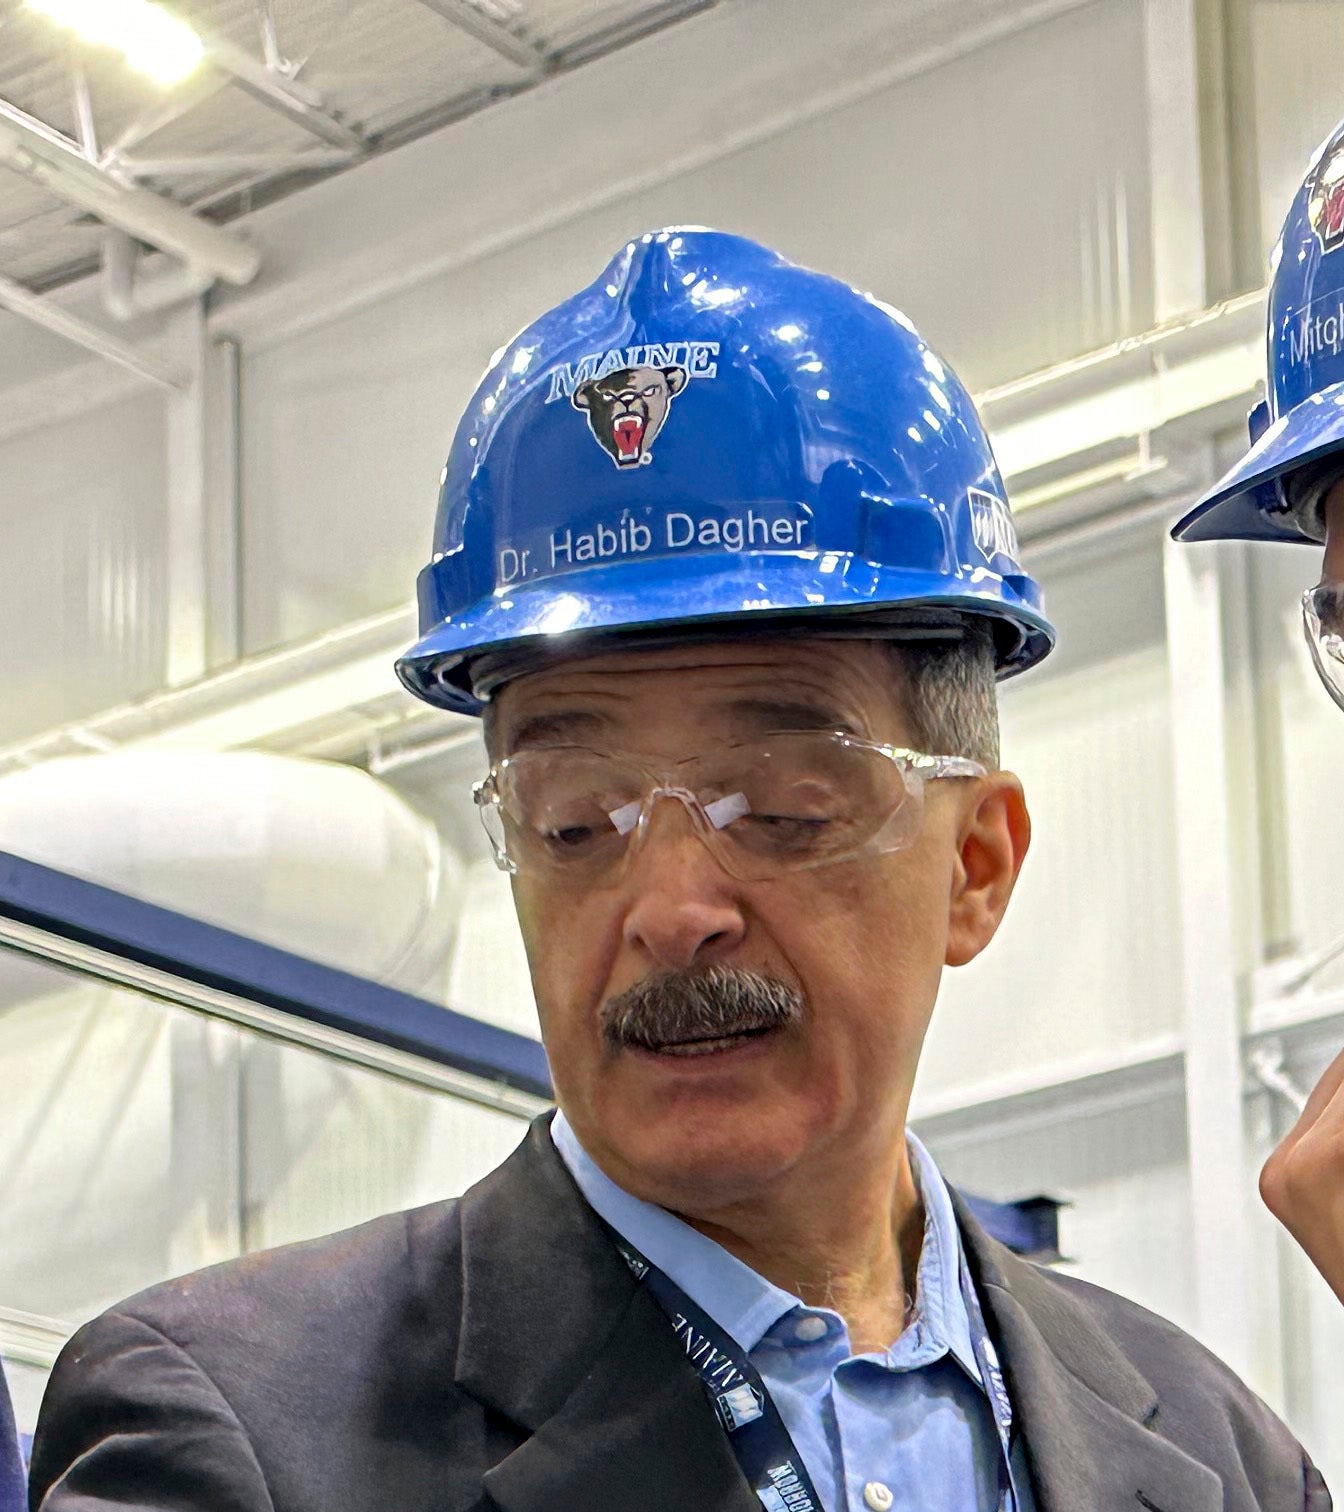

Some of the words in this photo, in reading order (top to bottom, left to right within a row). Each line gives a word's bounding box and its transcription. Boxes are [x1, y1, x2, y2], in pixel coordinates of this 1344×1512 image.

[544, 341, 721, 404] MAINE
[500, 549, 538, 582] Dr.
[550, 516, 651, 568] Habib
[666, 509, 808, 552] Dagher
